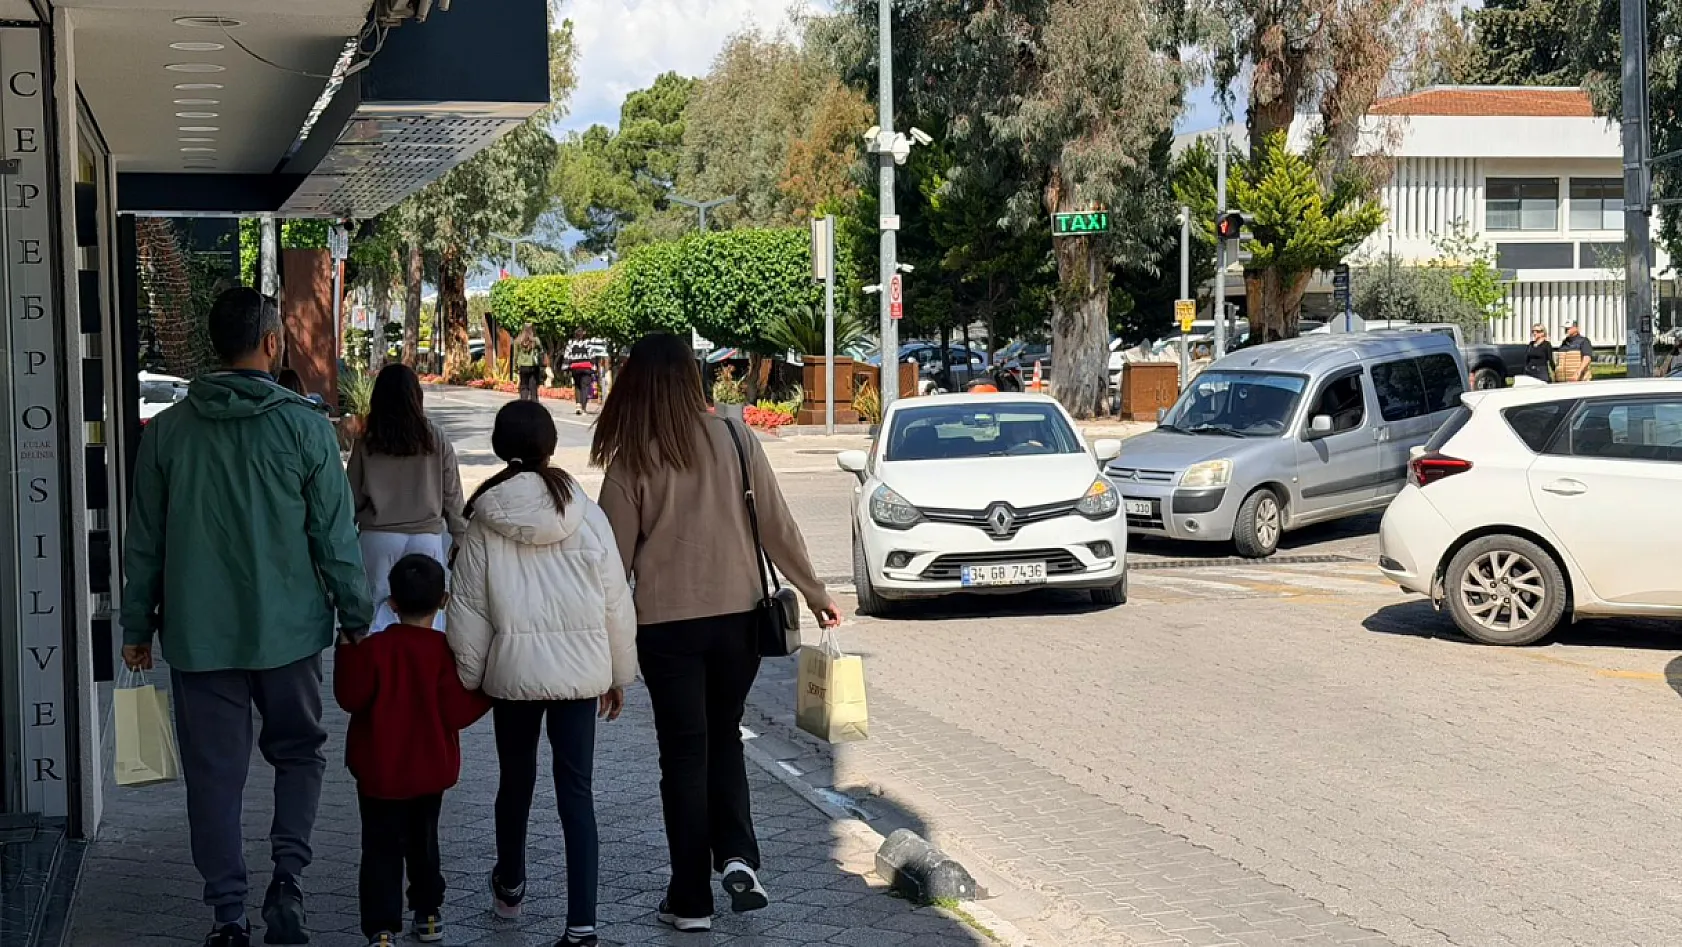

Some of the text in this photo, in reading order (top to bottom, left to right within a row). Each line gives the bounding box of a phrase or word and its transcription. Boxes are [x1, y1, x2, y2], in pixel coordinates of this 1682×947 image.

[9, 71, 52, 430] СЕРЕБРО
[1056, 213, 1107, 231] TAXI
[27, 477, 62, 782] SILVER
[970, 567, 985, 581] 34
[1012, 563, 1042, 579] 7436
